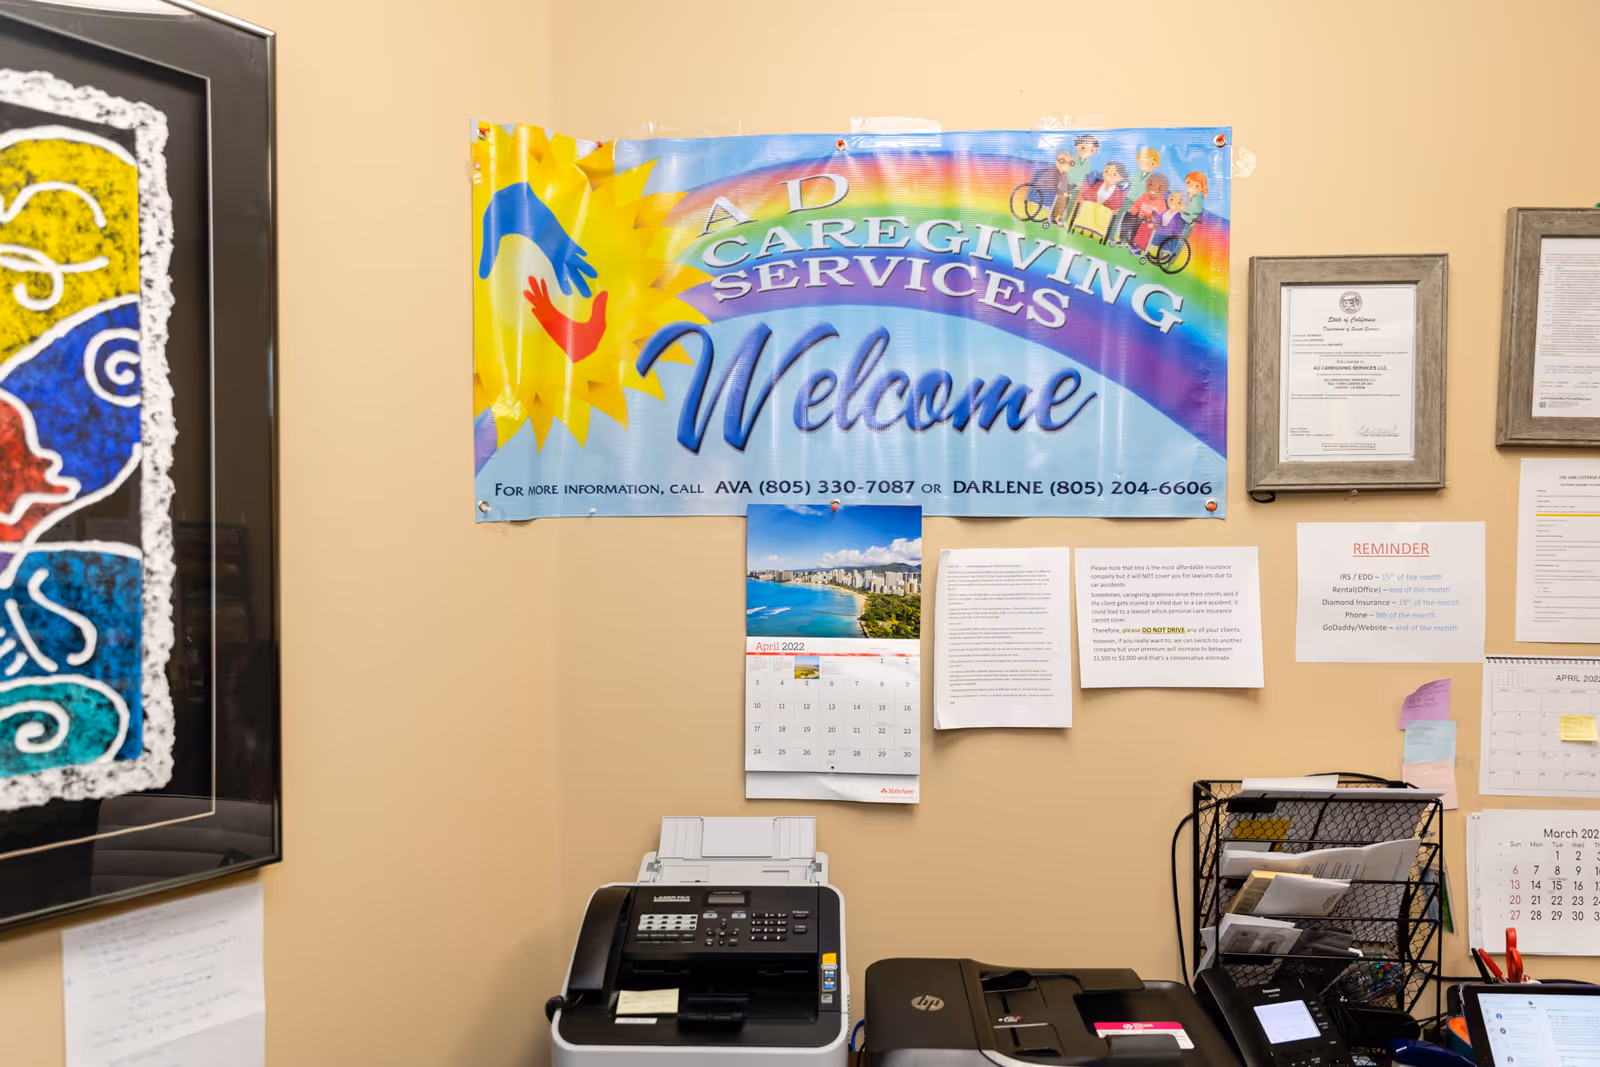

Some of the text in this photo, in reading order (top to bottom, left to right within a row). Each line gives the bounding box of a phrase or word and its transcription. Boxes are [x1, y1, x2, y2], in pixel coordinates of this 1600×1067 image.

[697, 173, 849, 238] A D
[702, 216, 1184, 334] CAREGIVING
[710, 255, 1070, 329] SERVICES
[636, 320, 1097, 454] Welcome
[528, 485, 559, 496] MORE
[564, 483, 664, 496] INFORMATION,
[670, 483, 704, 495] CALL
[715, 481, 753, 494] AVA
[759, 480, 811, 496] (805)
[817, 480, 915, 495] 330-7087
[921, 484, 942, 494] OR
[953, 480, 1044, 495] DARLENE
[1050, 481, 1104, 497] (805)
[1111, 480, 1213, 496] 204-6606
[1353, 543, 1429, 554] REMINDER
[1323, 624, 1387, 632] GoDaddy/Website
[756, 642, 804, 652] April 2022
[1544, 829, 1599, 839] March 202
[1556, 851, 1581, 860] 1 2
[1513, 865, 1581, 875] 6 7 8 9
[1510, 880, 1583, 890] 13 14 15 16
[1510, 895, 1584, 905] 20 21 22 23
[1510, 910, 1584, 921] 27 28 29 30
[914, 994, 942, 1011] hp
